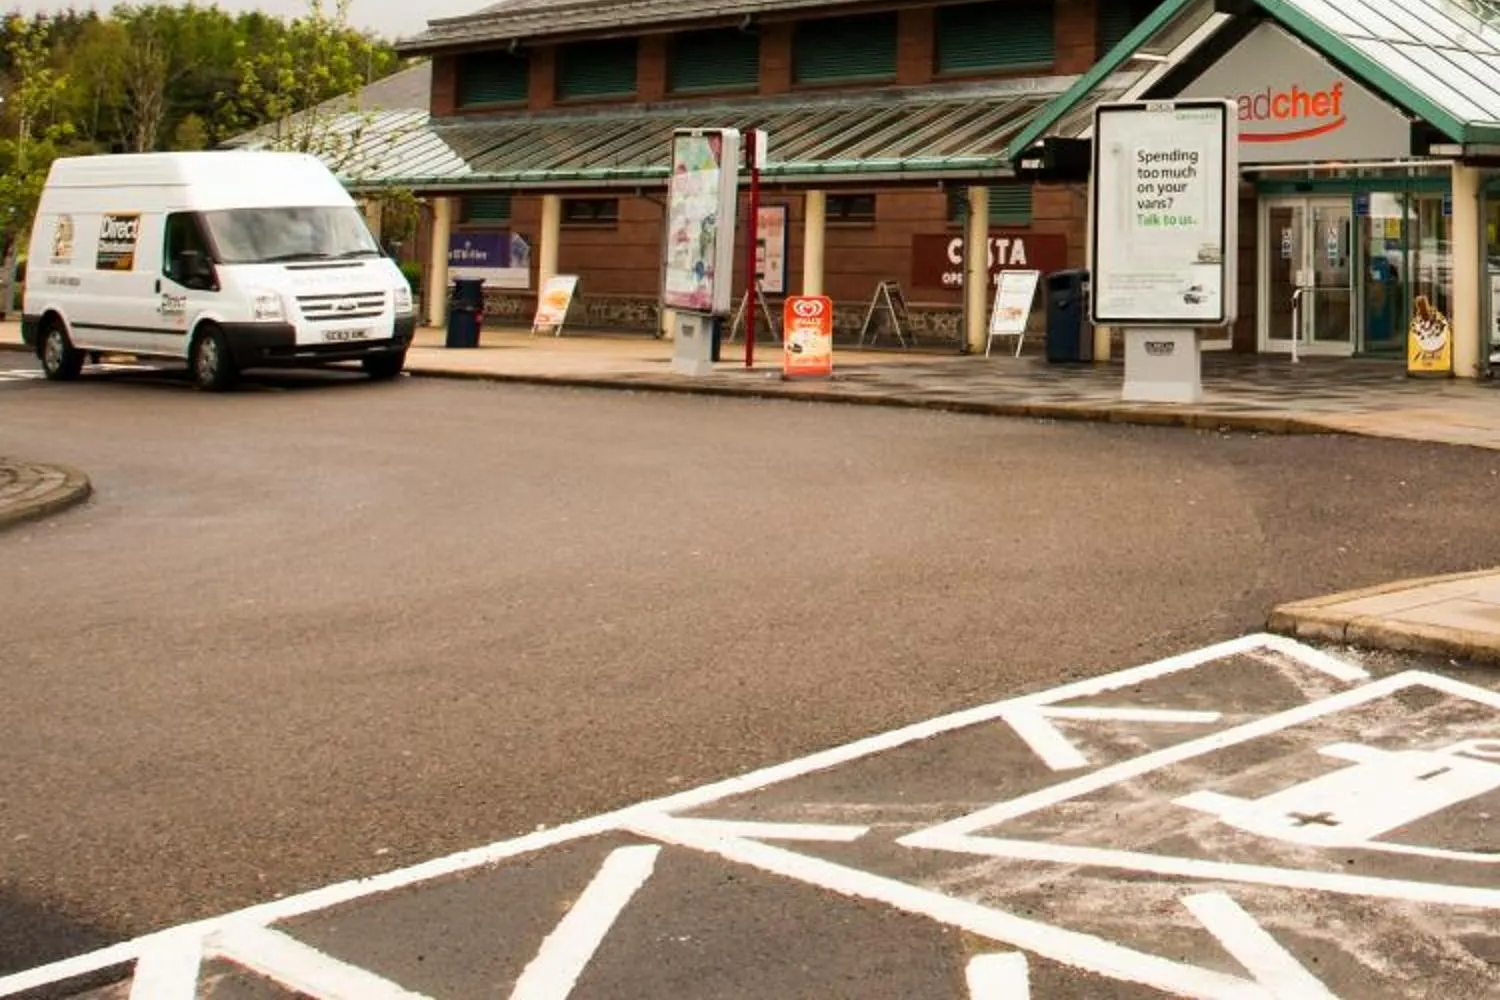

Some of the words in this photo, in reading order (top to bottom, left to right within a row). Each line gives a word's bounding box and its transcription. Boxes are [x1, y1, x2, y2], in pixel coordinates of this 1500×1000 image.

[1137, 149, 1199, 164] Spending
[1137, 167, 1159, 179] too
[1161, 166, 1197, 179] much
[1137, 183, 1154, 194] on
[1157, 183, 1188, 196] your
[1137, 198, 1174, 209] vans?
[1137, 214, 1160, 225] Talk
[1163, 215, 1177, 225] to
[947, 238, 1027, 266] CSTA
